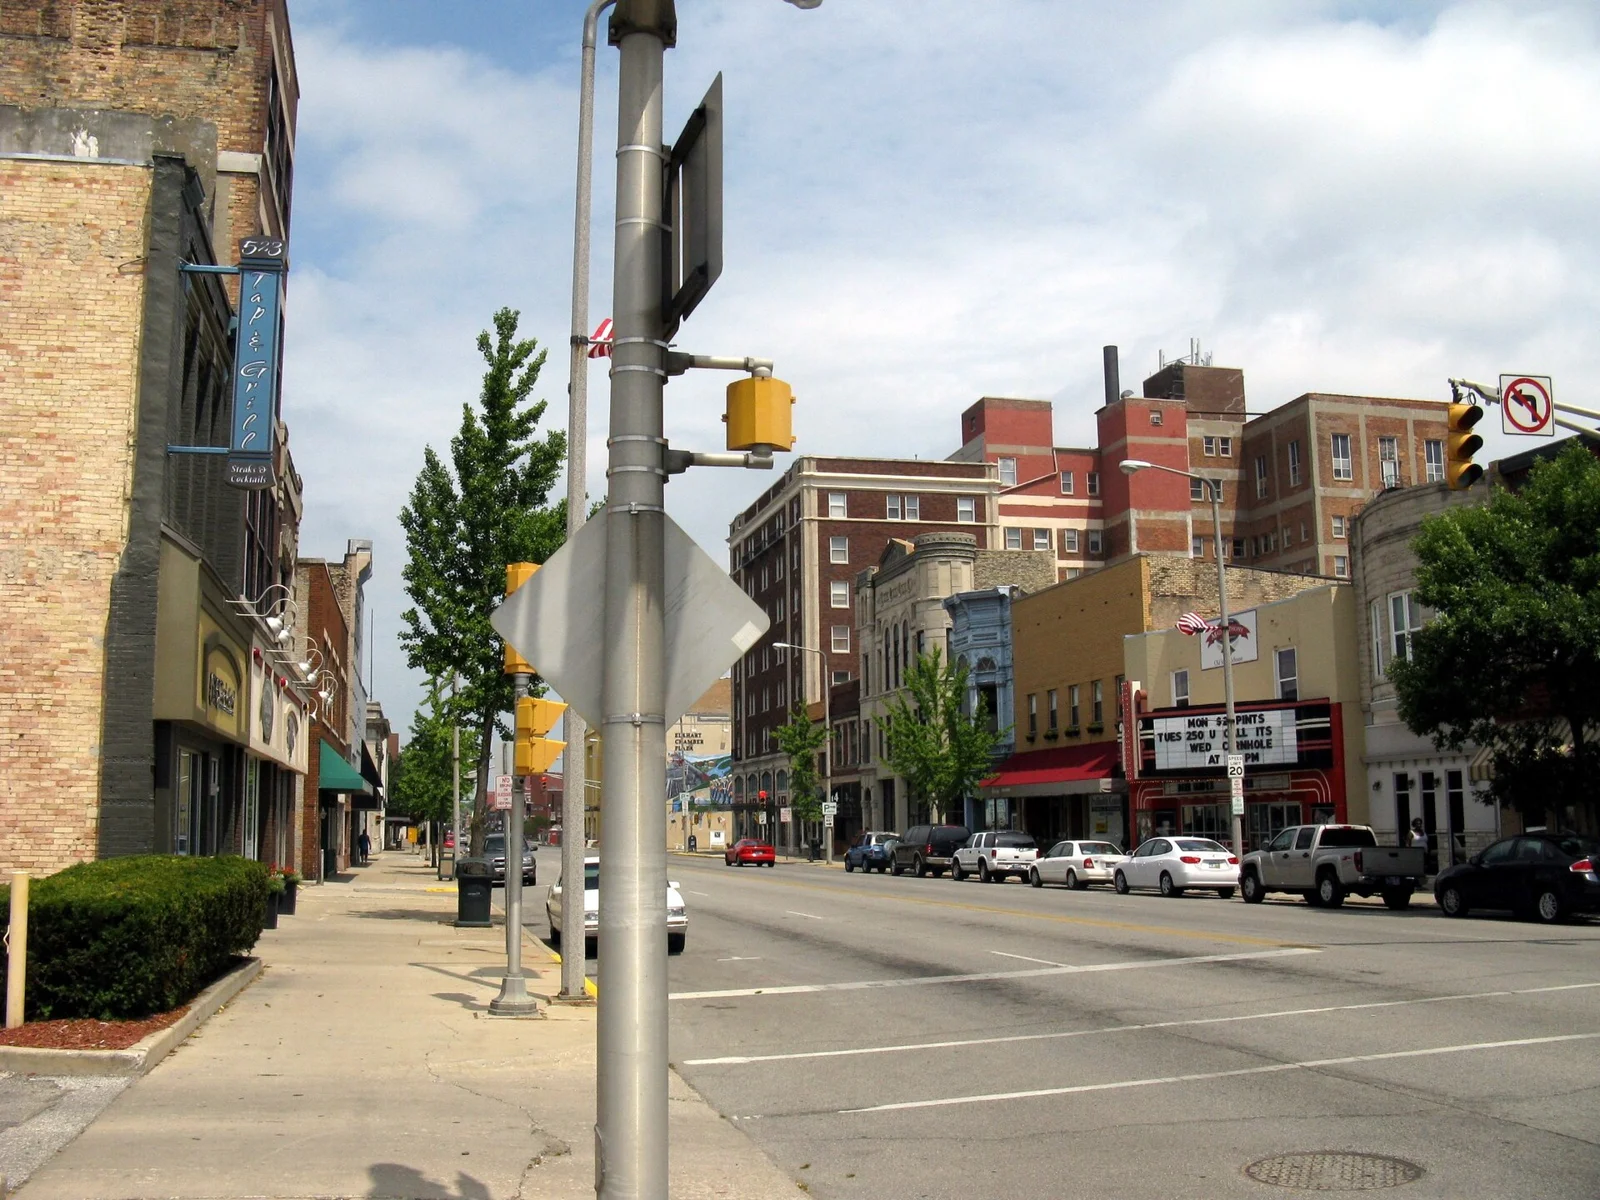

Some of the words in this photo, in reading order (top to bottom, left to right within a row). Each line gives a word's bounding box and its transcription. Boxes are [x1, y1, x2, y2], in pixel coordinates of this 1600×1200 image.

[241, 240, 283, 256] 523
[248, 271, 273, 326] Tap
[240, 360, 267, 449] Grill
[230, 464, 256, 474] Steaks
[230, 475, 267, 484] Cocktails
[1187, 718, 1208, 728] MON
[1235, 713, 1265, 725] PINTS
[1158, 731, 1182, 743] TUES
[1186, 730, 1204, 741] 250
[1209, 729, 1216, 739] U
[1223, 727, 1248, 738] CLL
[1255, 726, 1272, 736] ITS
[1190, 742, 1212, 753] WED
[1222, 739, 1273, 751] CRNHOLE
[1208, 754, 1220, 765] AT
[1245, 752, 1260, 763] PM
[1229, 766, 1243, 775] 20
